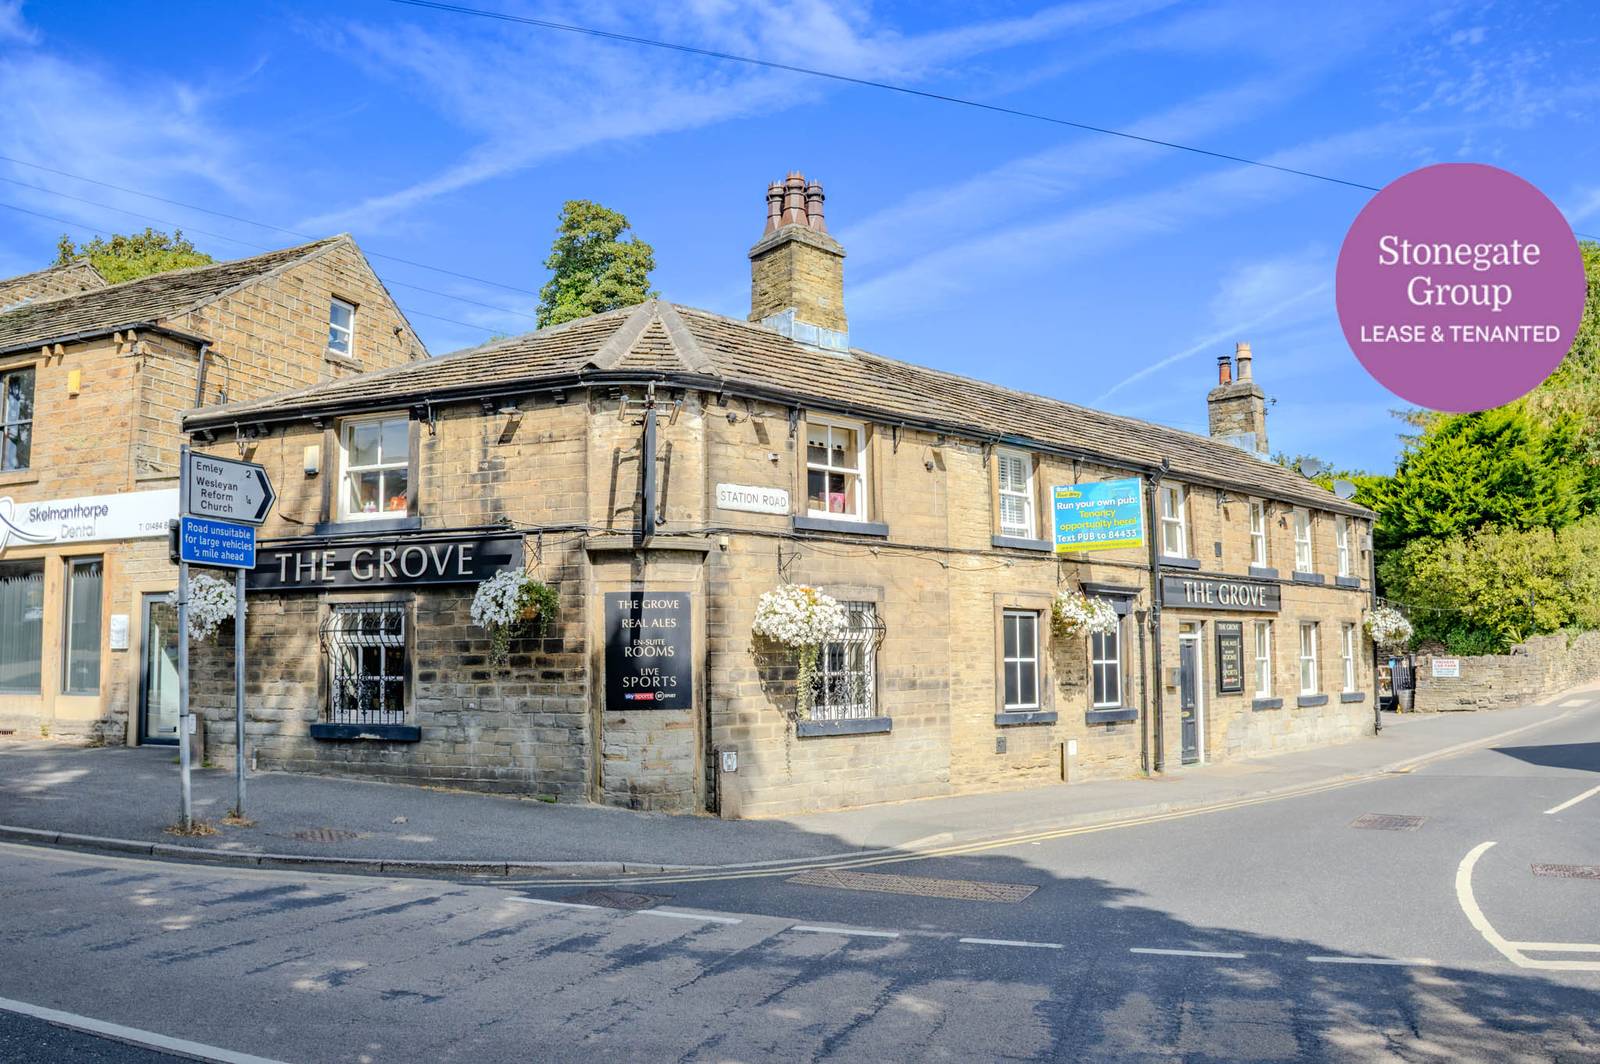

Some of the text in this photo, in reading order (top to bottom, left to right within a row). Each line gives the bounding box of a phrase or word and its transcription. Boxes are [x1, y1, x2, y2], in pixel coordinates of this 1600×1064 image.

[196, 461, 252, 478] Emley 2
[196, 476, 238, 491] Wesleyan
[201, 488, 233, 501] Reform
[720, 490, 787, 507] STATION ROAD
[200, 500, 233, 513] Church
[1056, 502, 1074, 510] Run
[1075, 500, 1094, 510] your
[29, 503, 109, 523] Skelmanthorpe
[1080, 510, 1116, 518] Tenancy
[60, 523, 97, 539] Dental
[187, 522, 251, 539] Road unsuitable
[1060, 520, 1112, 532] opportunity
[185, 534, 252, 551] for large vehicles
[1056, 534, 1076, 543] Text
[1078, 532, 1095, 541] PUB
[1097, 532, 1106, 540] to
[202, 548, 219, 558] mile
[221, 549, 244, 561] ahead
[275, 543, 474, 583] THE GROVE
[1183, 581, 1267, 606] THE GROVE
[618, 600, 680, 610] THE GROVE
[622, 618, 677, 628] REAL ALES
[624, 646, 674, 658] ROOMS
[640, 668, 660, 676] LIVE
[622, 676, 677, 688] SPORTS
